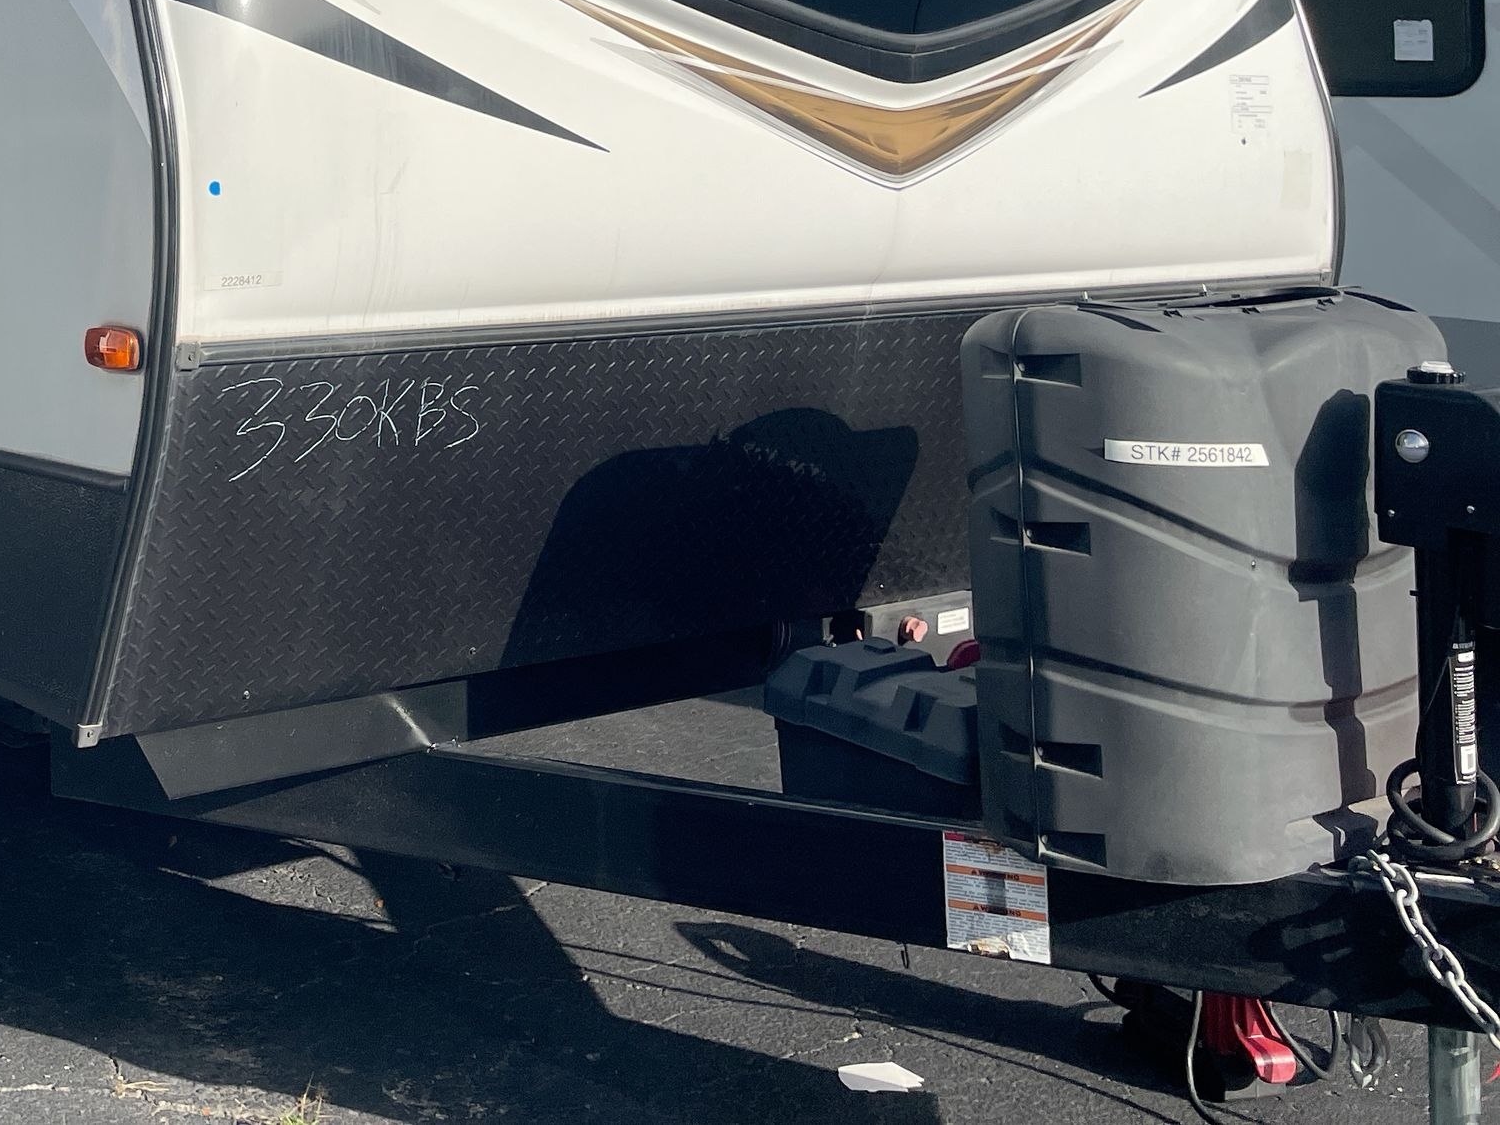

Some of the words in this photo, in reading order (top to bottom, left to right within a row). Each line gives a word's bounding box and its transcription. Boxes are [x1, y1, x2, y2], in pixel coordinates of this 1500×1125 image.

[221, 275, 262, 288] 2228412
[221, 377, 480, 483] 330KBS
[1130, 444, 1182, 462] STK#
[1187, 446, 1253, 463] 2561842
